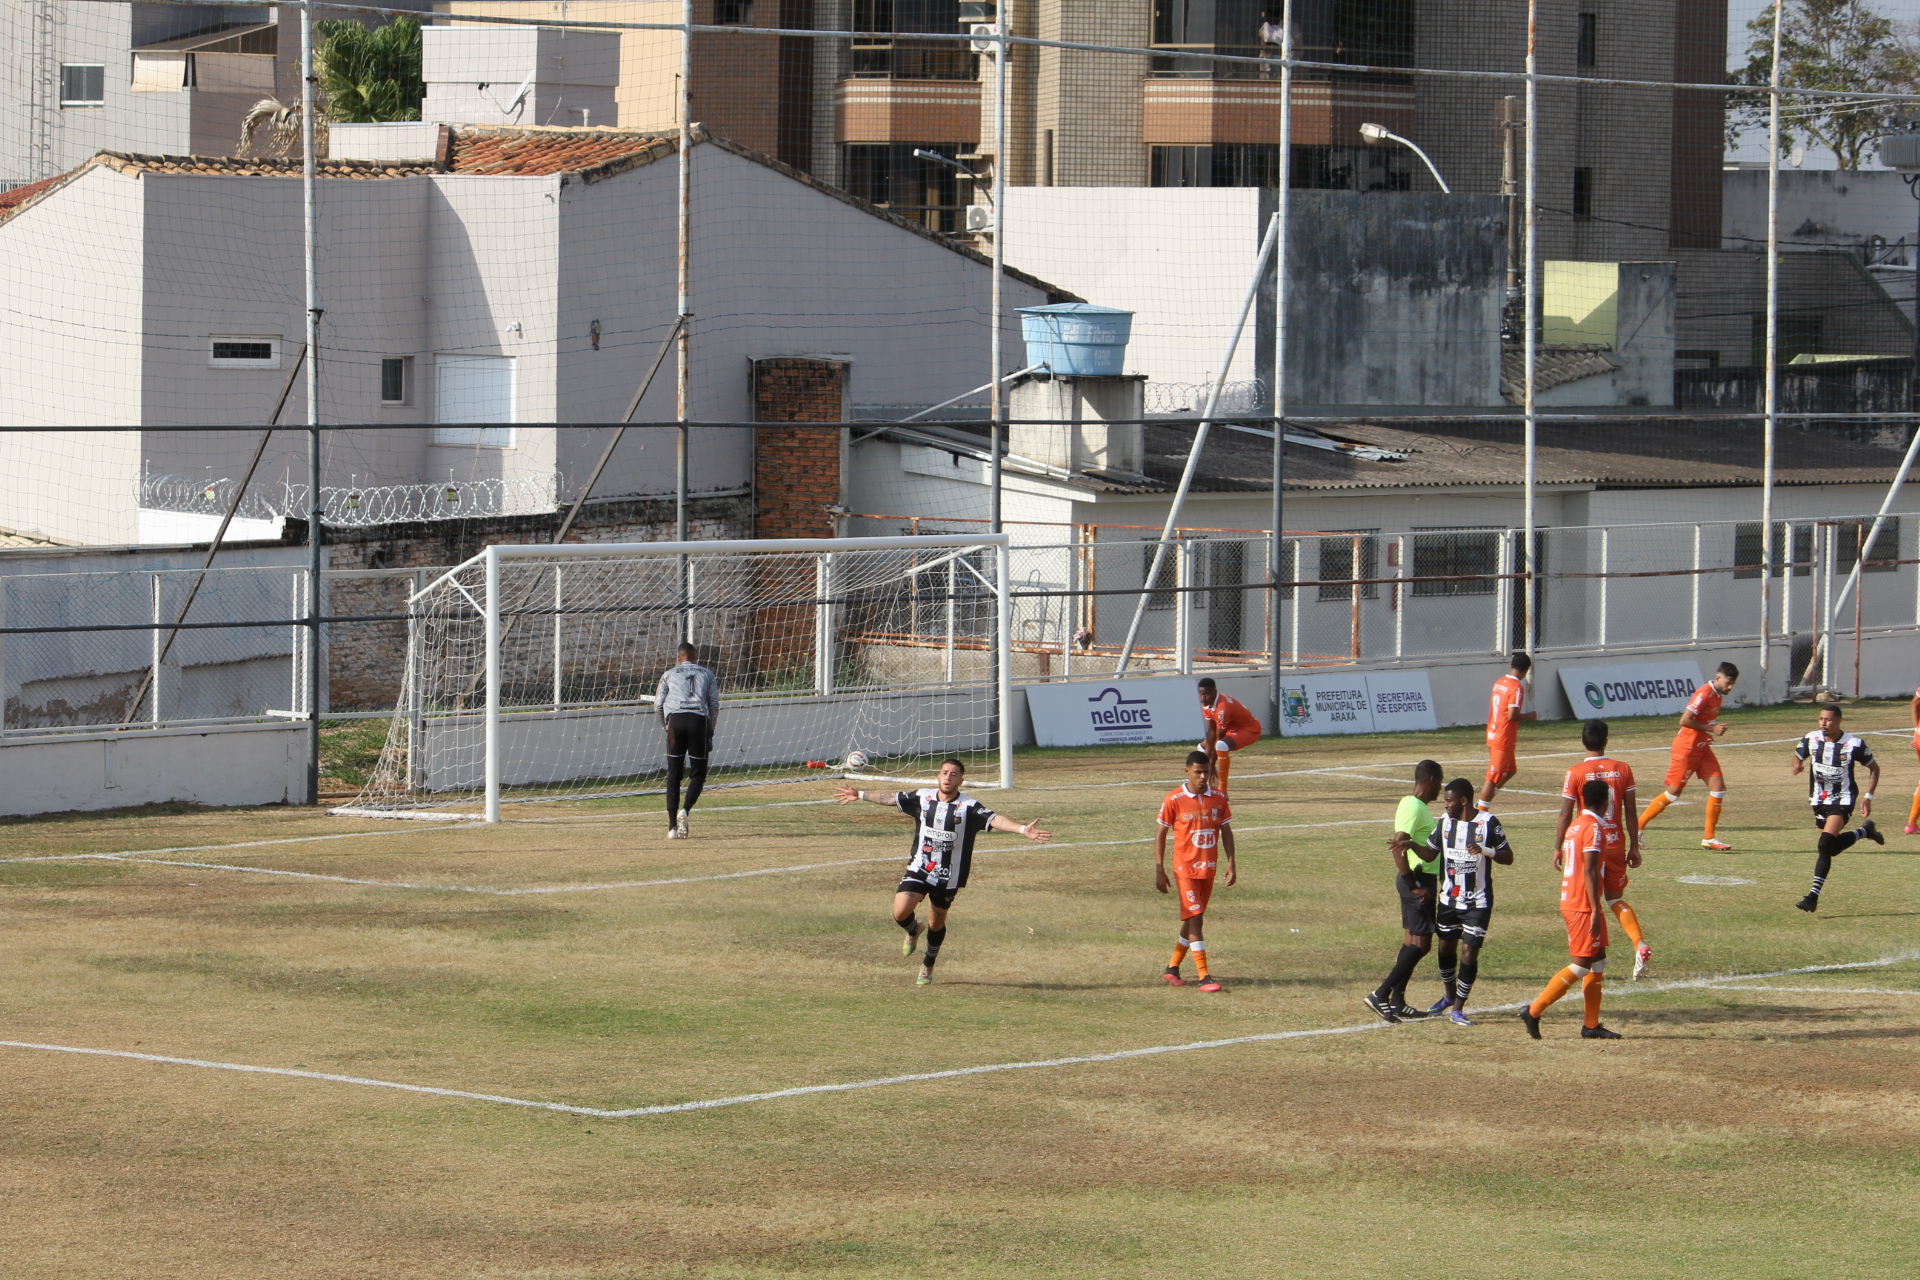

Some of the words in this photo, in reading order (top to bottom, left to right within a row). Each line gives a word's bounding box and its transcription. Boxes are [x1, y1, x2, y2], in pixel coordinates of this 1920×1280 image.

[685, 674, 695, 697] 1
[1603, 678, 1696, 702] CONCREARA
[1316, 690, 1362, 701] PREFEITURA
[1377, 692, 1422, 703] SECRETARIA
[1315, 701, 1355, 712] MUNICIPAL
[1357, 700, 1367, 710] DE
[1377, 704, 1388, 714] DE
[1389, 702, 1427, 713] ESPORTES
[1091, 706, 1151, 725] nelore
[1197, 834, 1214, 845] BH
